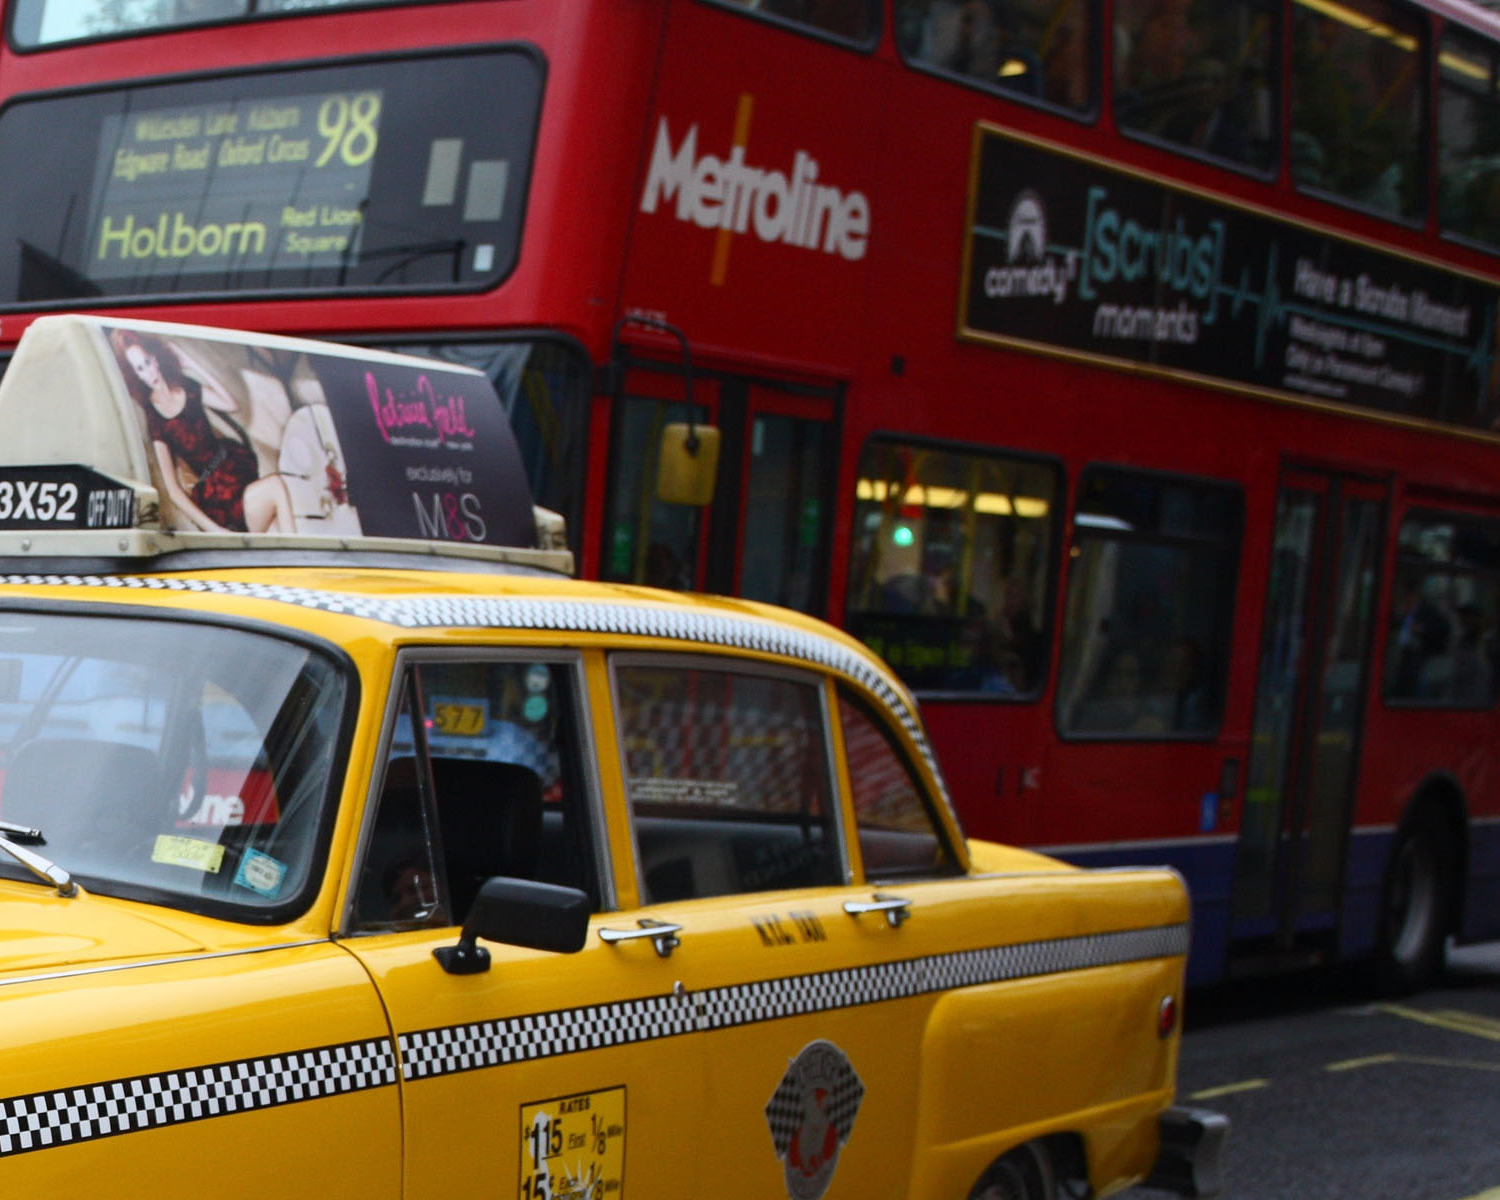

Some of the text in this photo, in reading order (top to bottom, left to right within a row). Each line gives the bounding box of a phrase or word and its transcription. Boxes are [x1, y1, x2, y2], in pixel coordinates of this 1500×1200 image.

[314, 93, 381, 168] 98
[640, 114, 872, 262] Metroline
[98, 206, 363, 260] Holborn Red Lion
[287, 234, 348, 257] Square
[1092, 302, 1198, 344] moments
[87, 491, 106, 527] OFF
[106, 488, 133, 527] DUTY
[412, 490, 487, 542] M&S
[559, 1097, 591, 1114] RATES
